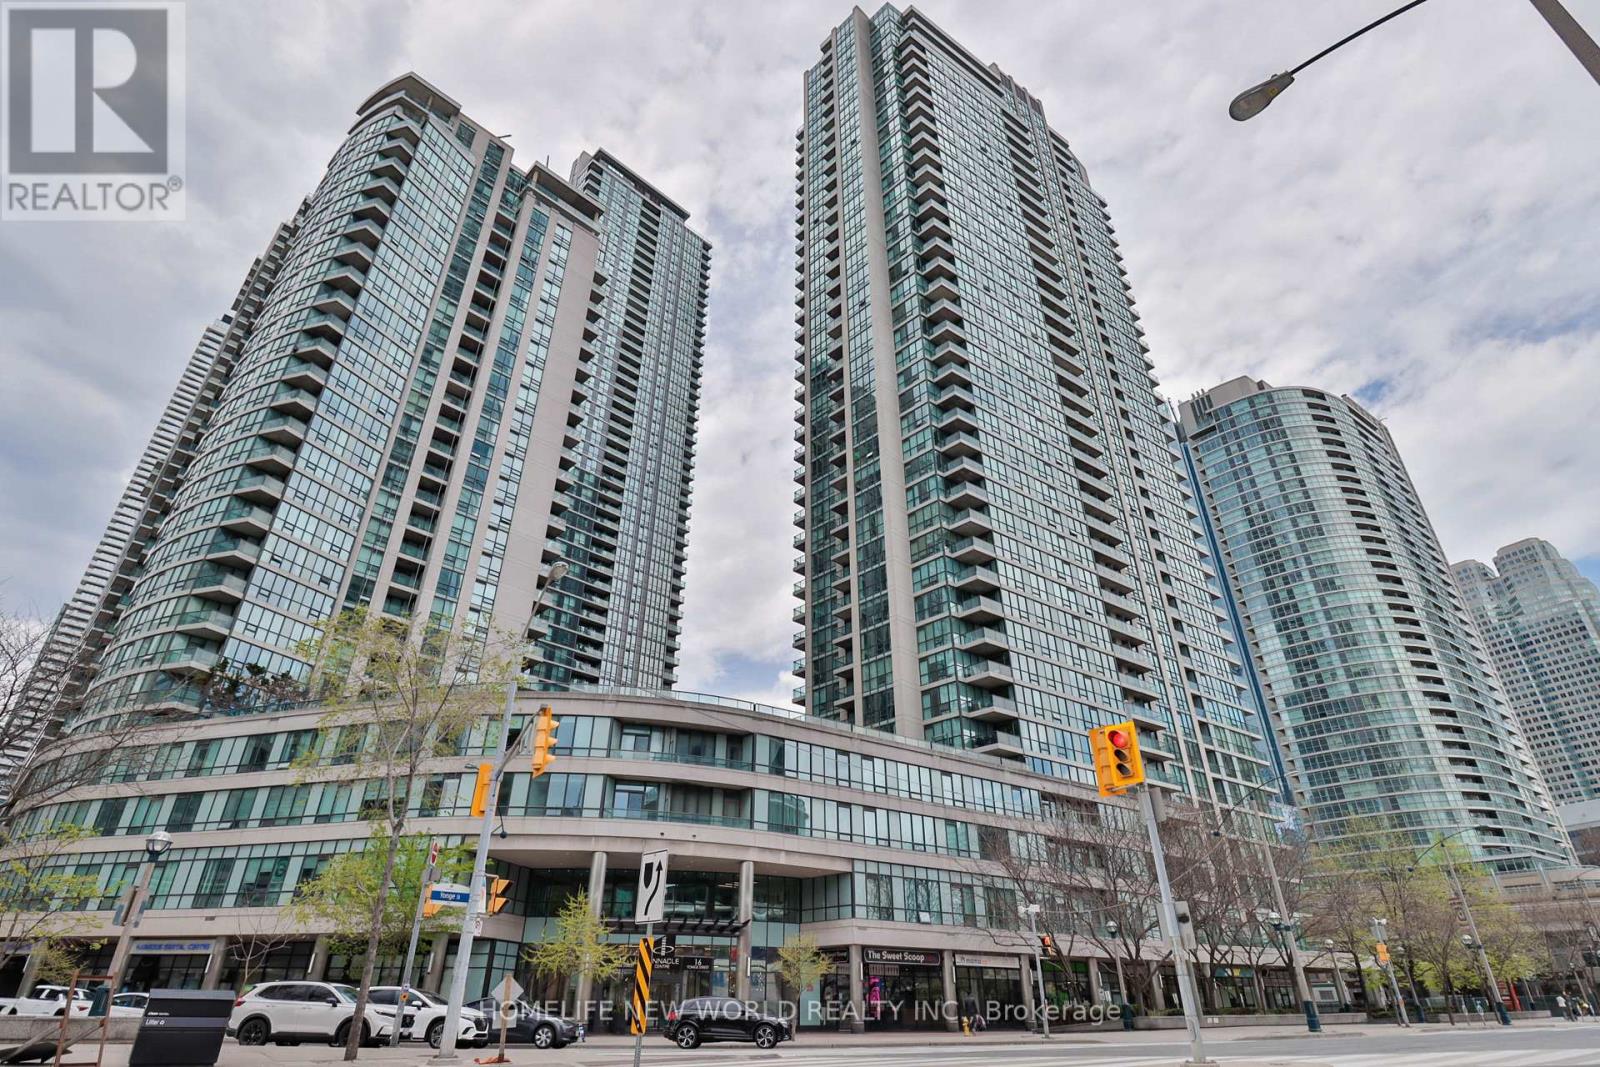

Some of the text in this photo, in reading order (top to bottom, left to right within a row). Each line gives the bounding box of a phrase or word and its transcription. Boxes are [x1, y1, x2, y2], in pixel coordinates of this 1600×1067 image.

[868, 950, 880, 959] The
[881, 950, 902, 960] Sweet
[903, 951, 925, 963] Scoop
